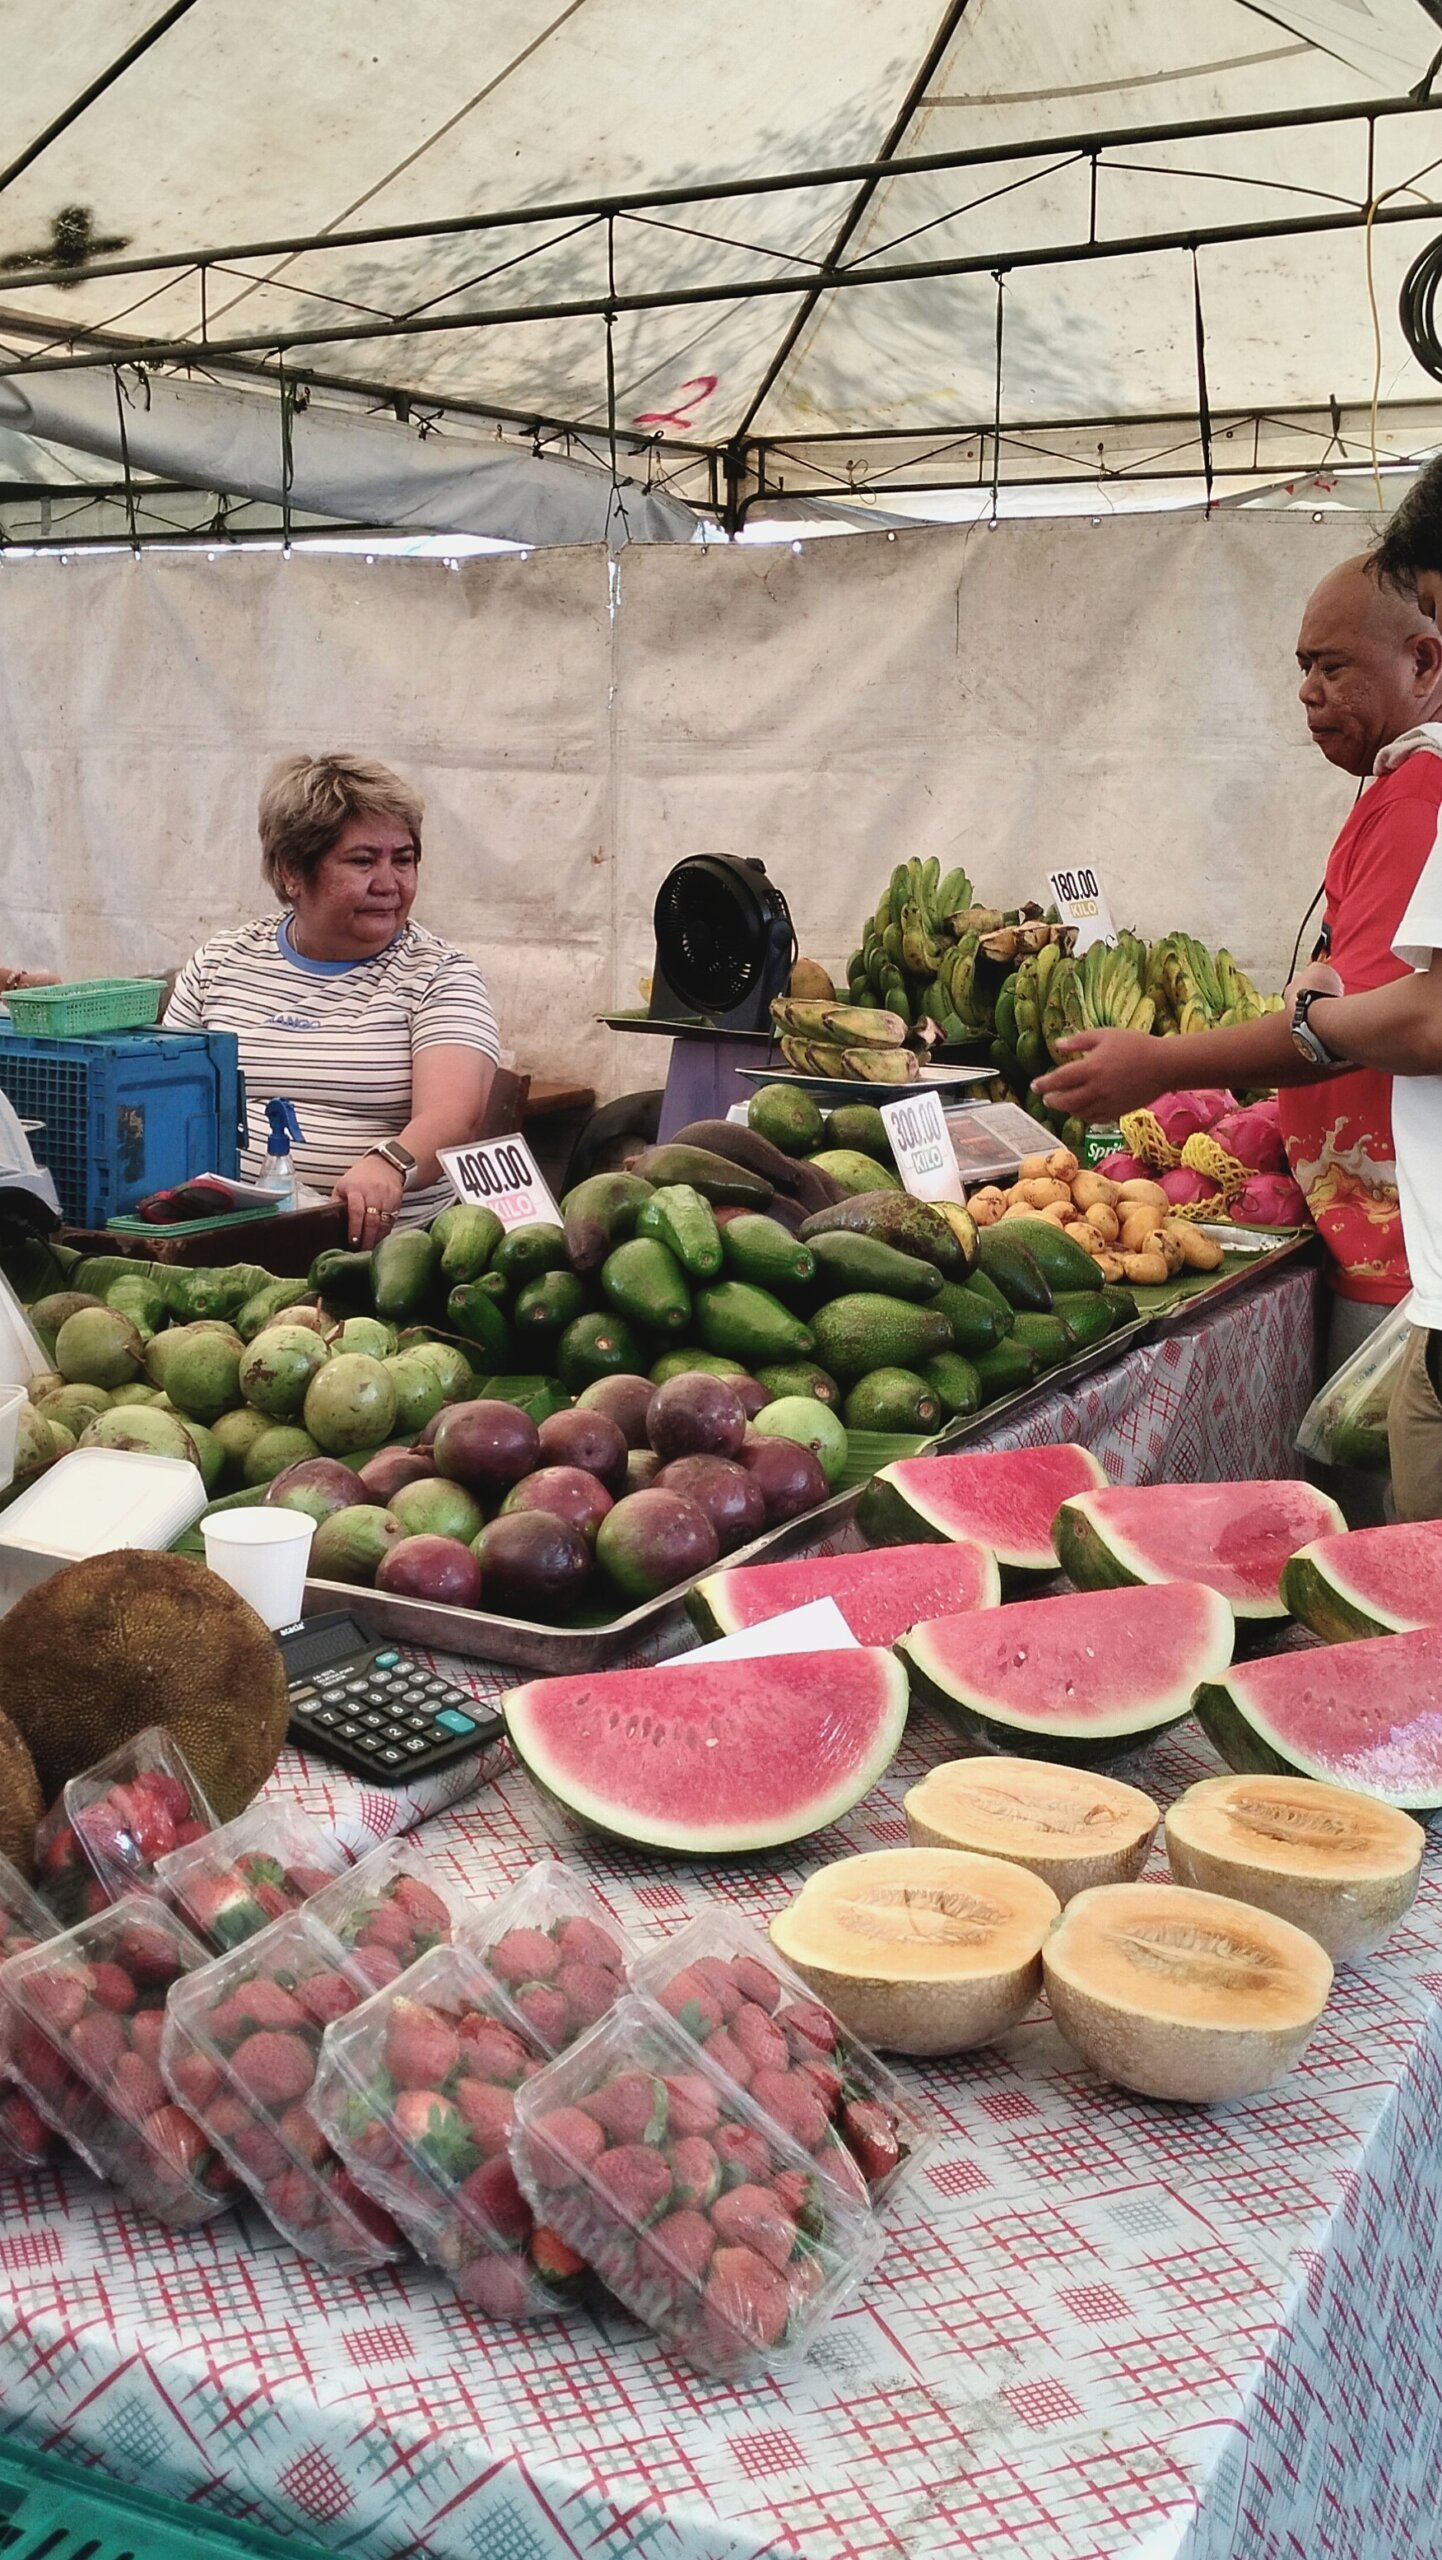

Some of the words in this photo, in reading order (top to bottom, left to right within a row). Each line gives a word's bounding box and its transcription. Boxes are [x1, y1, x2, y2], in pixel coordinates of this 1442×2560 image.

[1051, 869, 1099, 902] 180.00
[1070, 902, 1097, 917] KILO
[891, 1101, 941, 1152] 300.00
[912, 1149, 942, 1173] KILO
[456, 1144, 532, 1199] 400.00
[488, 1195, 535, 1221] KILO
[369, 1693, 383, 1703] 9
[347, 1703, 361, 1712] 8
[391, 1705, 404, 1714] 6
[322, 1712, 335, 1722] 7
[367, 1715, 380, 1725] 5
[410, 1717, 425, 1727] 3
[345, 1725, 357, 1734] 4
[388, 1727, 403, 1737] 2
[365, 1738, 377, 1746] 1
[406, 1738, 425, 1750] 00
[385, 1750, 399, 1760] 0
